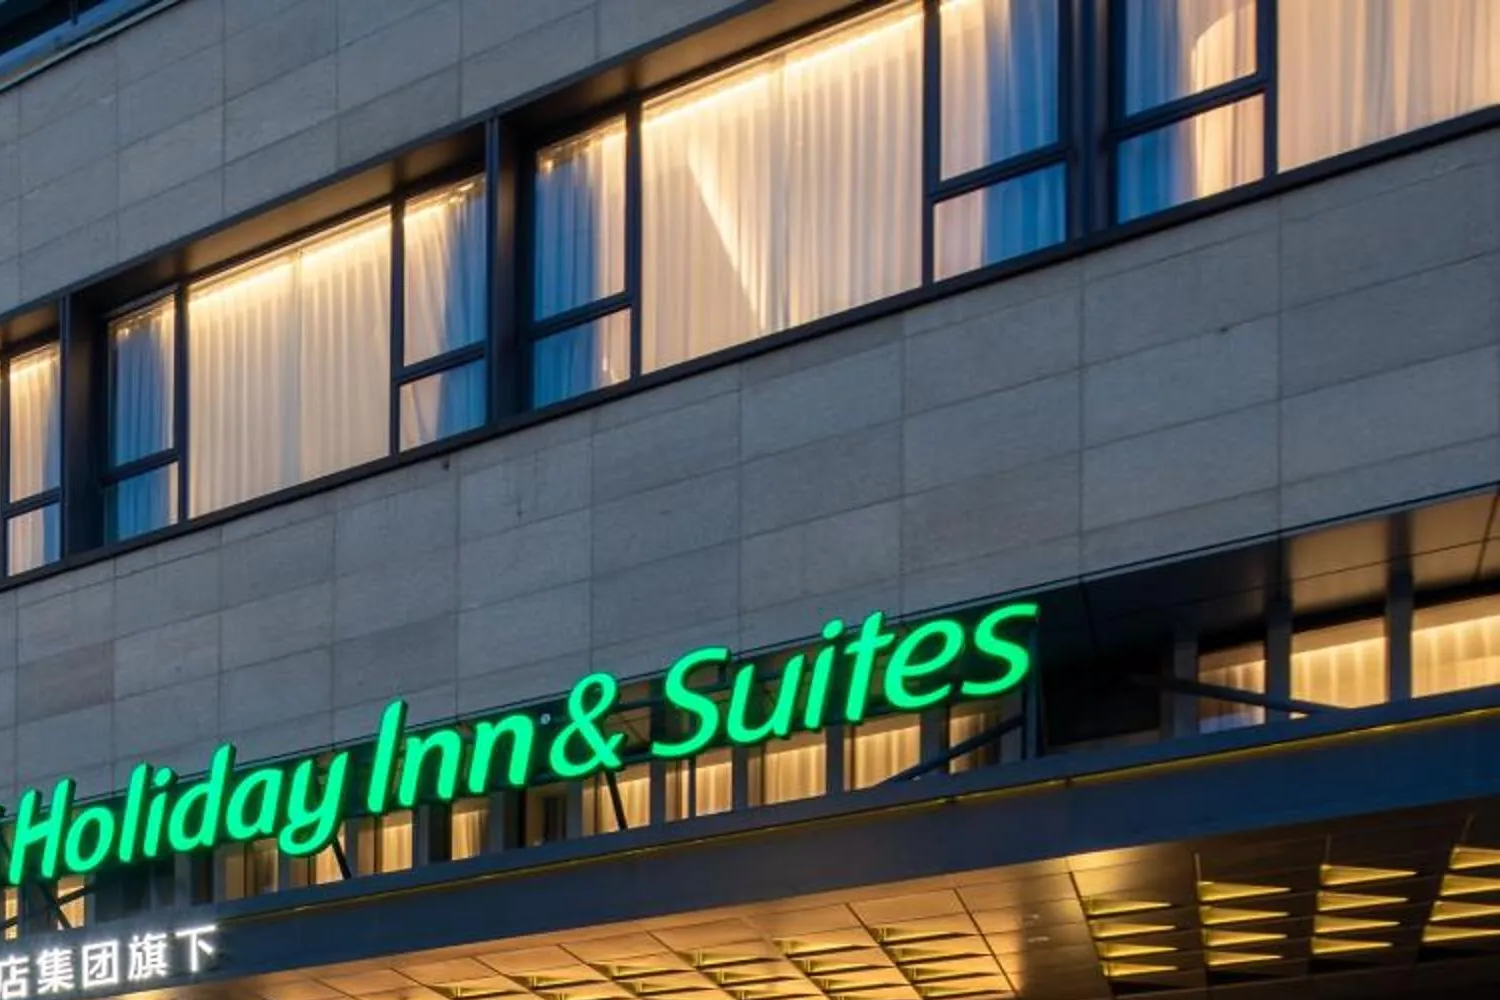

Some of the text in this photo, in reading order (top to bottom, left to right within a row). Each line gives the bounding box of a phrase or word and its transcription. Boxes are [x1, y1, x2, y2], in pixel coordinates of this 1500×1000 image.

[8, 603, 1039, 886] Holiday Inn & Suites
